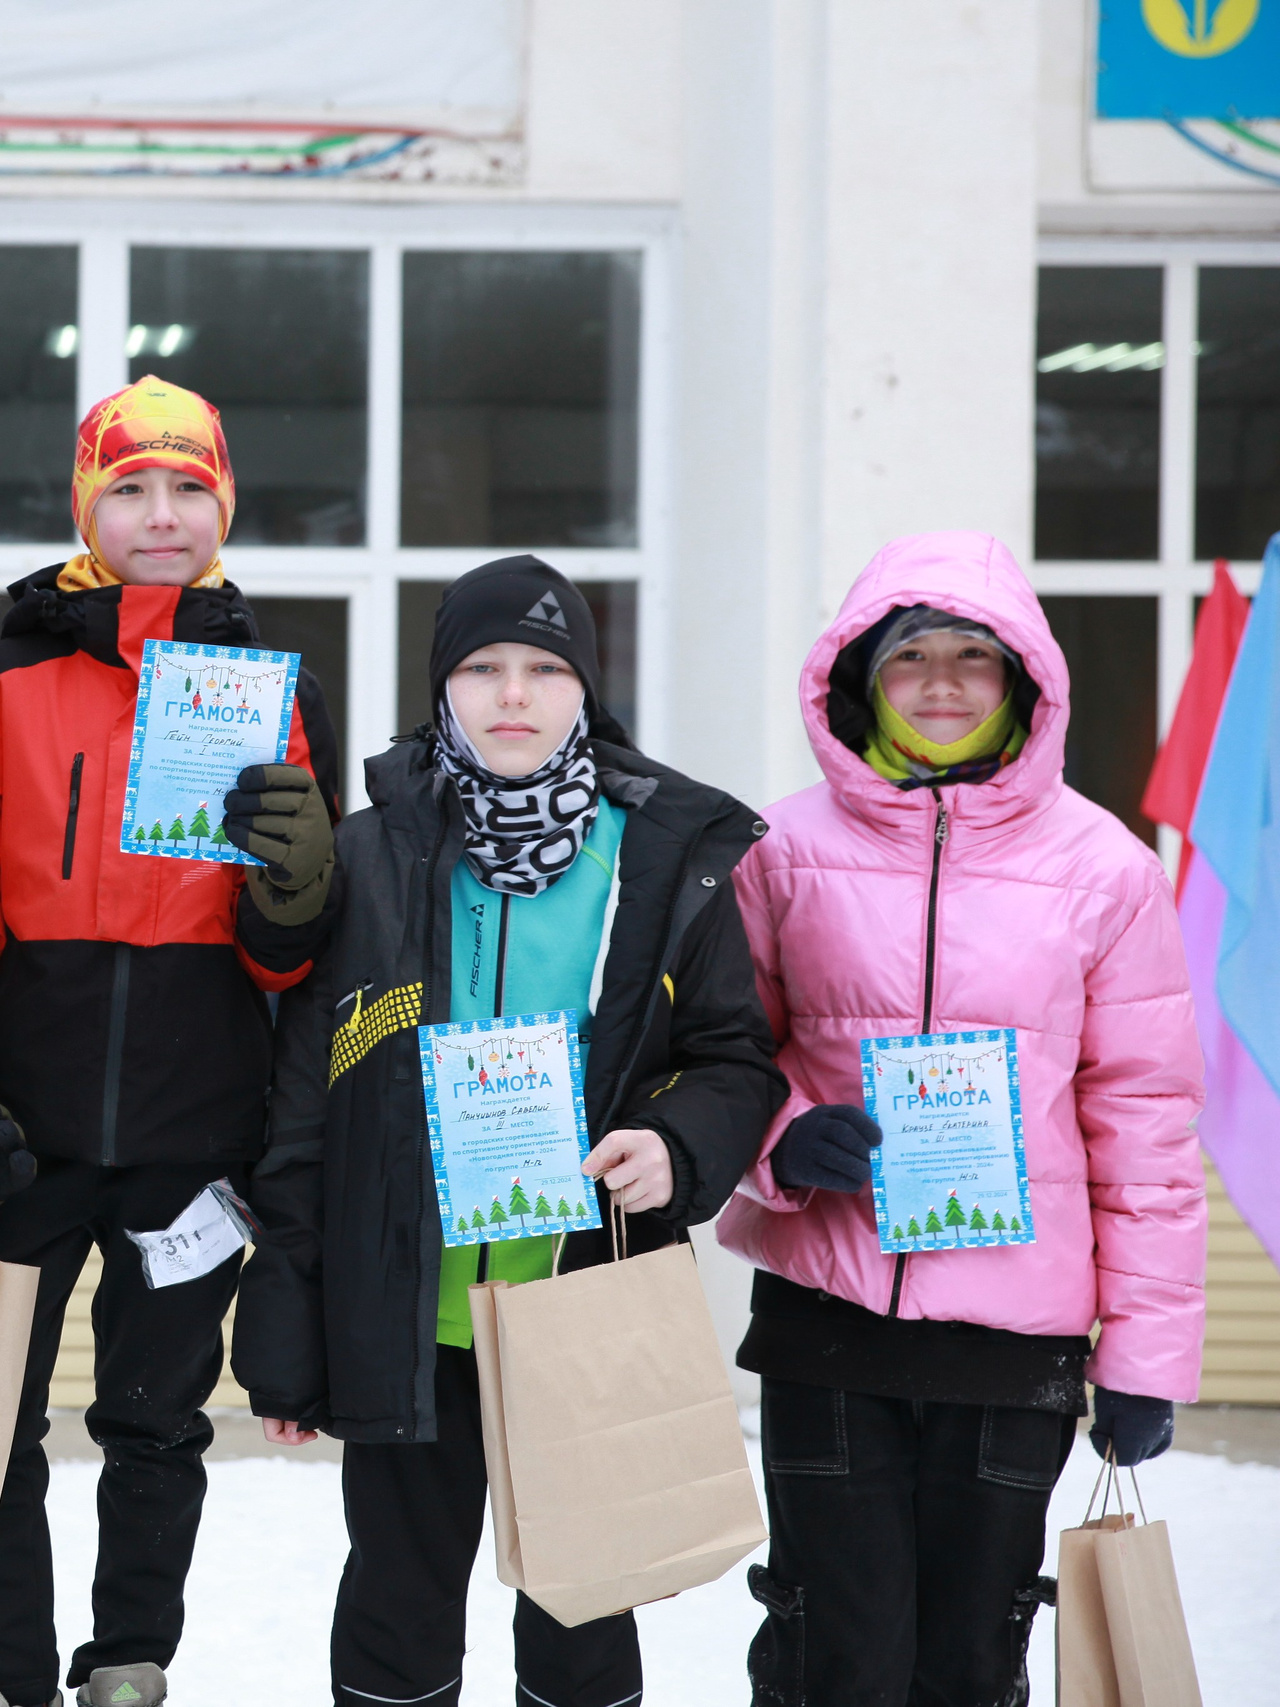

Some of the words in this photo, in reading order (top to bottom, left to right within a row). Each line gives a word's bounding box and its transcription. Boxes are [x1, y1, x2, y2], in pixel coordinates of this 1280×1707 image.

[116, 440, 203, 458] FISCHER
[517, 620, 570, 640] FISCHER
[164, 701, 262, 725] ГРАМОТА
[188, 724, 237, 733] Награждается
[159, 766, 205, 775] спортивному
[167, 758, 202, 767] городских
[469, 920, 483, 998] FISCHER
[453, 1072, 553, 1098] ГРАМОТА
[480, 1096, 530, 1106] Награждается
[892, 1089, 992, 1111] ГРАМОТА
[510, 1120, 533, 1128] МЕСТО
[462, 1145, 509, 1154] спортивному
[510, 1137, 572, 1149] ориентированию
[467, 1137, 504, 1146] городских
[504, 1130, 559, 1141] соревнованиях
[494, 1164, 518, 1172] группе
[541, 1177, 571, 1185] 29.12.2024
